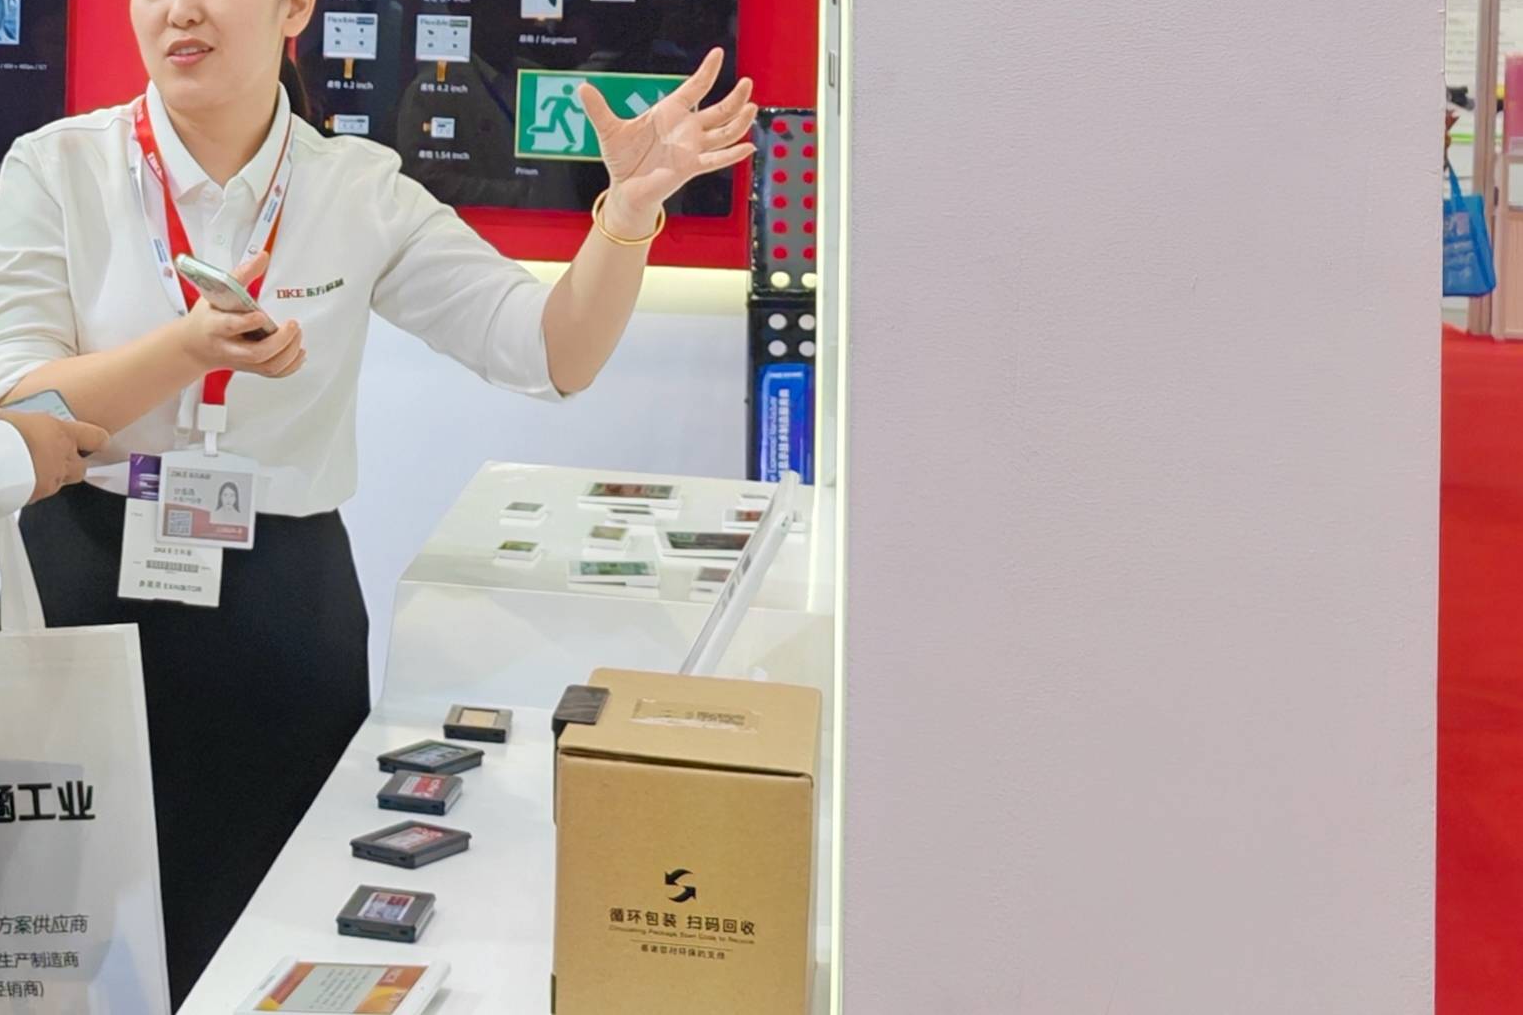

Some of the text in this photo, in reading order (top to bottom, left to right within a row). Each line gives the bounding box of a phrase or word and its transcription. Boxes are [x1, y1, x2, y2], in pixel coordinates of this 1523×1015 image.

[609, 907, 756, 936] 循环包装 扫码回收
